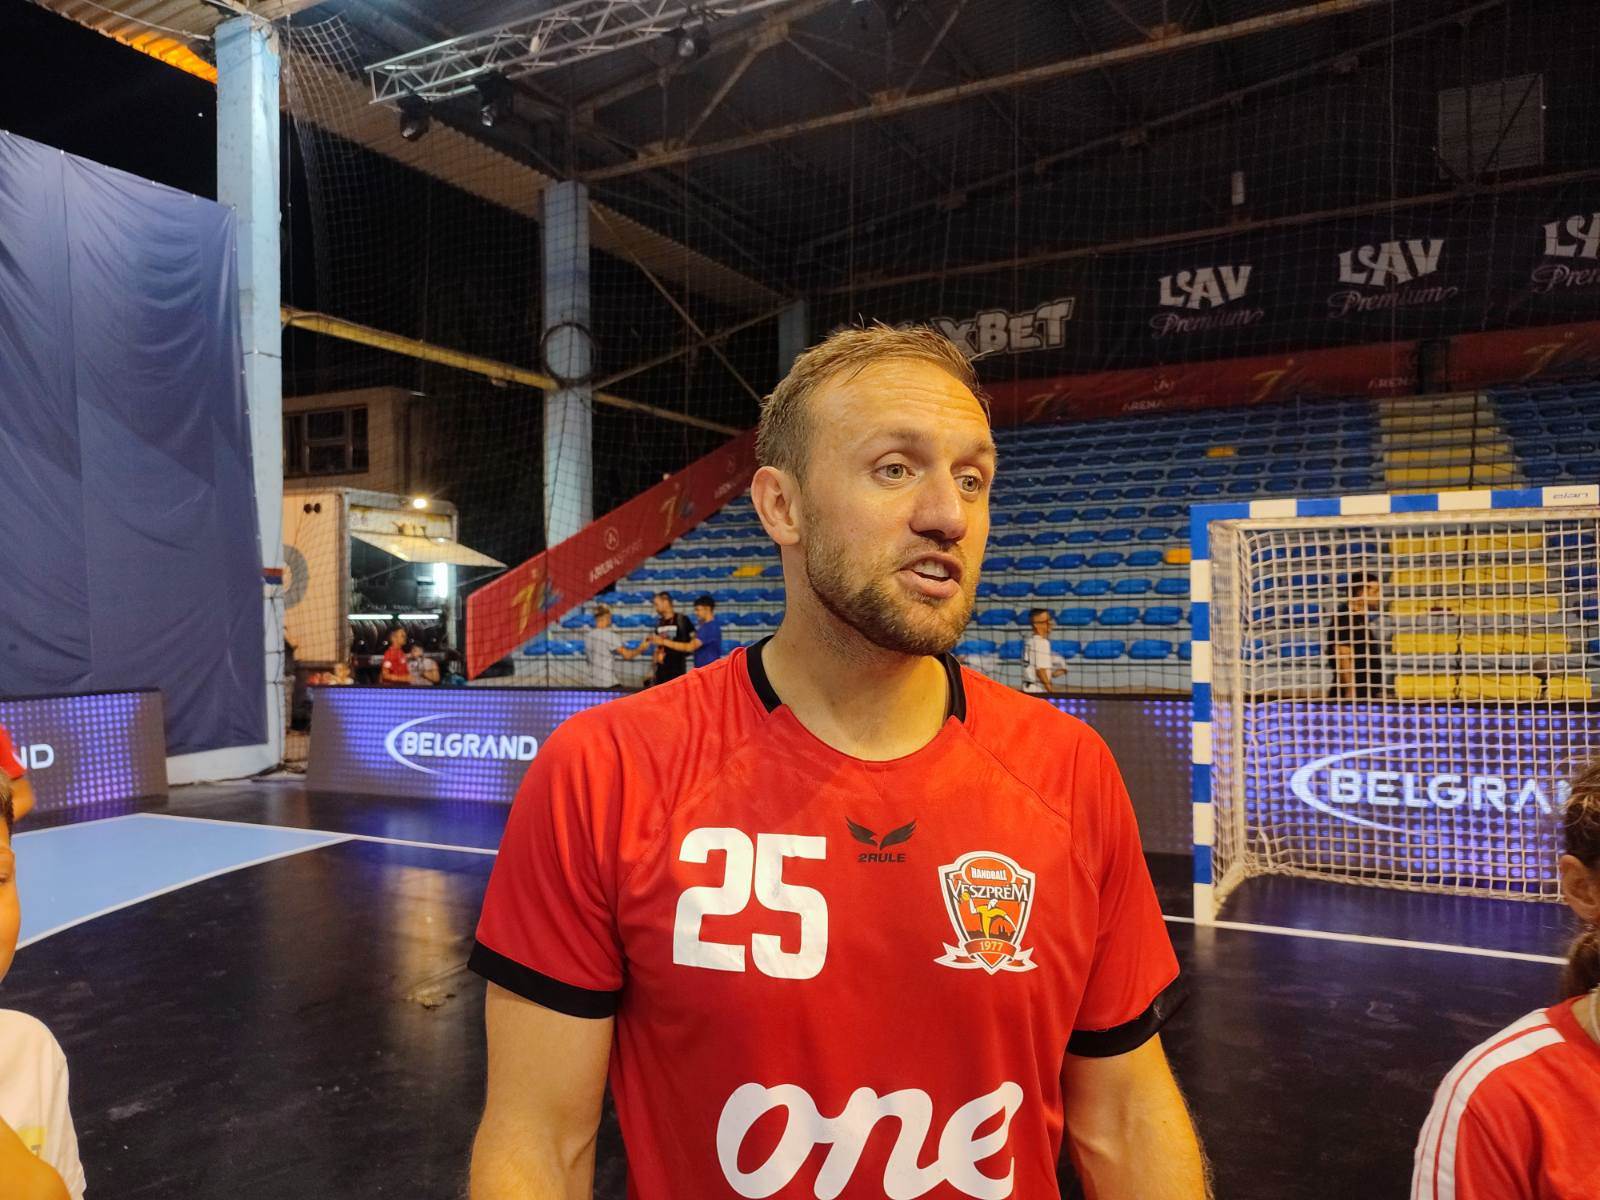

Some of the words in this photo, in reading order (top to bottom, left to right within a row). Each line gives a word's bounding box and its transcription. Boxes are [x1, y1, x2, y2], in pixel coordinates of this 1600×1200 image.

[1337, 239, 1445, 287] LAV
[1158, 265, 1252, 309] LAV
[1327, 286, 1458, 318] Premium
[1150, 308, 1264, 336] Premium
[402, 731, 538, 761] BELGRAND
[857, 853, 906, 863] 2RULE
[970, 866, 1008, 881] HANDBALL
[672, 827, 828, 980] 25
[980, 941, 1004, 952] 1977
[716, 1081, 1024, 1200] one
